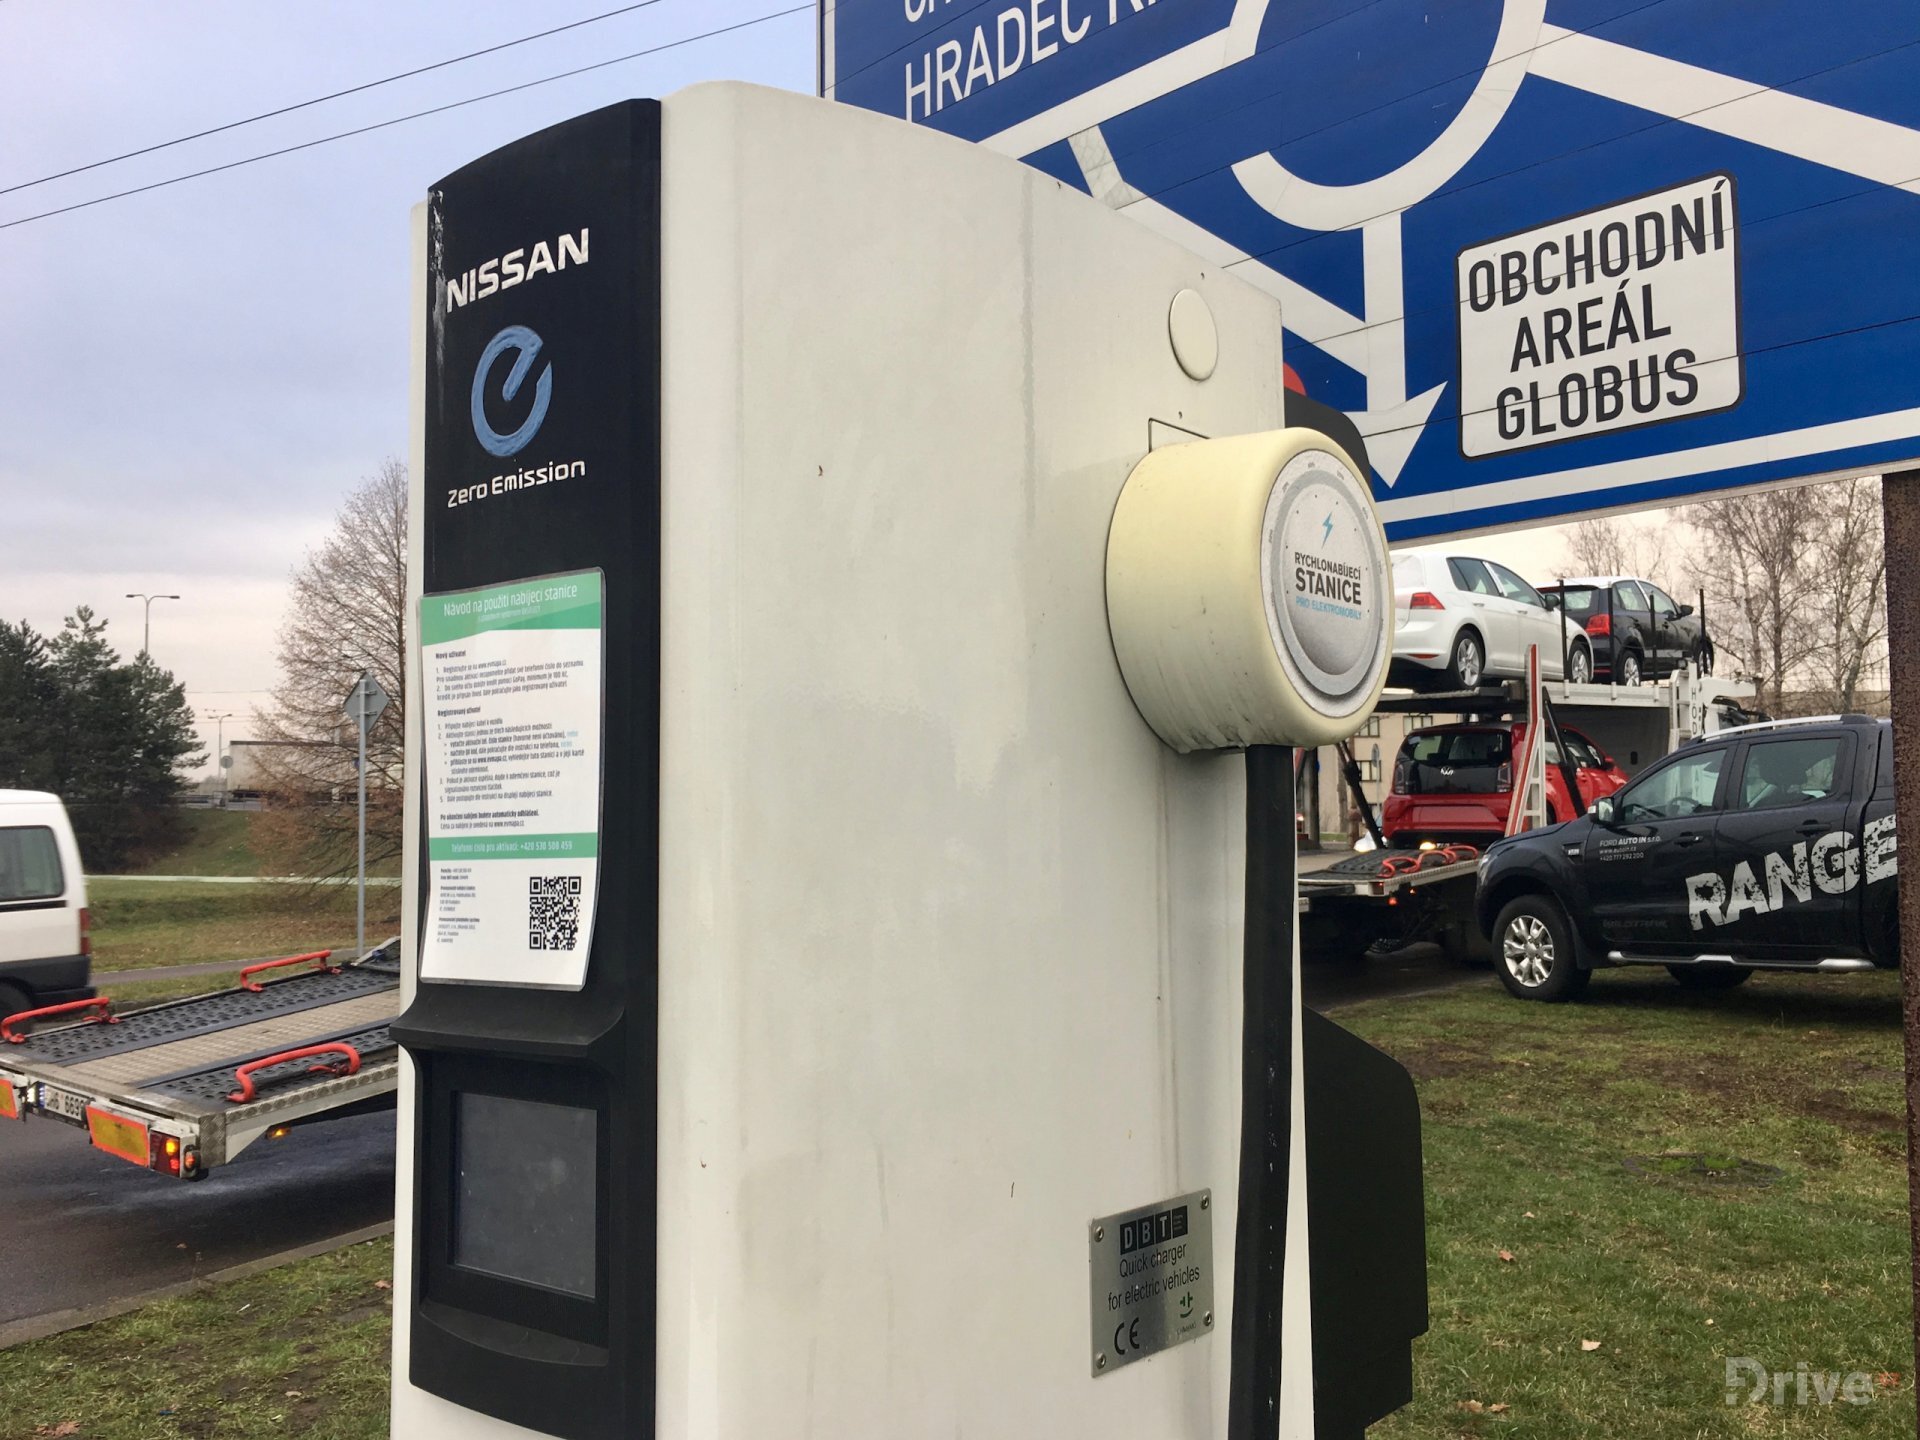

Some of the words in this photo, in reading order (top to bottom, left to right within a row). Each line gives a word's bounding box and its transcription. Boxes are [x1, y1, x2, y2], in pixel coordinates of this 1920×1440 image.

[905, 0, 1091, 121] HRADEC
[1469, 179, 1726, 312] OBCHODNÍ
[447, 228, 589, 313] NISSAN
[1510, 278, 1671, 373] AREÁL
[1497, 348, 1698, 440] GLOBUS
[448, 483, 487, 508] Zero
[492, 460, 585, 495] Emission
[1295, 552, 1361, 580] RYCHLONABÍJECÍ
[1296, 567, 1361, 605] STANICE
[545, 584, 577, 600] stanice
[1600, 839, 1618, 847] FORD
[1618, 837, 1638, 845] AUTO
[1122, 1213, 1170, 1250] DBT
[1119, 1253, 1148, 1277] Quick
[1151, 1243, 1186, 1266] charger
[1108, 1292, 1123, 1311] for
[1125, 1278, 1160, 1305] electric
[1163, 1266, 1200, 1290] vehicles
